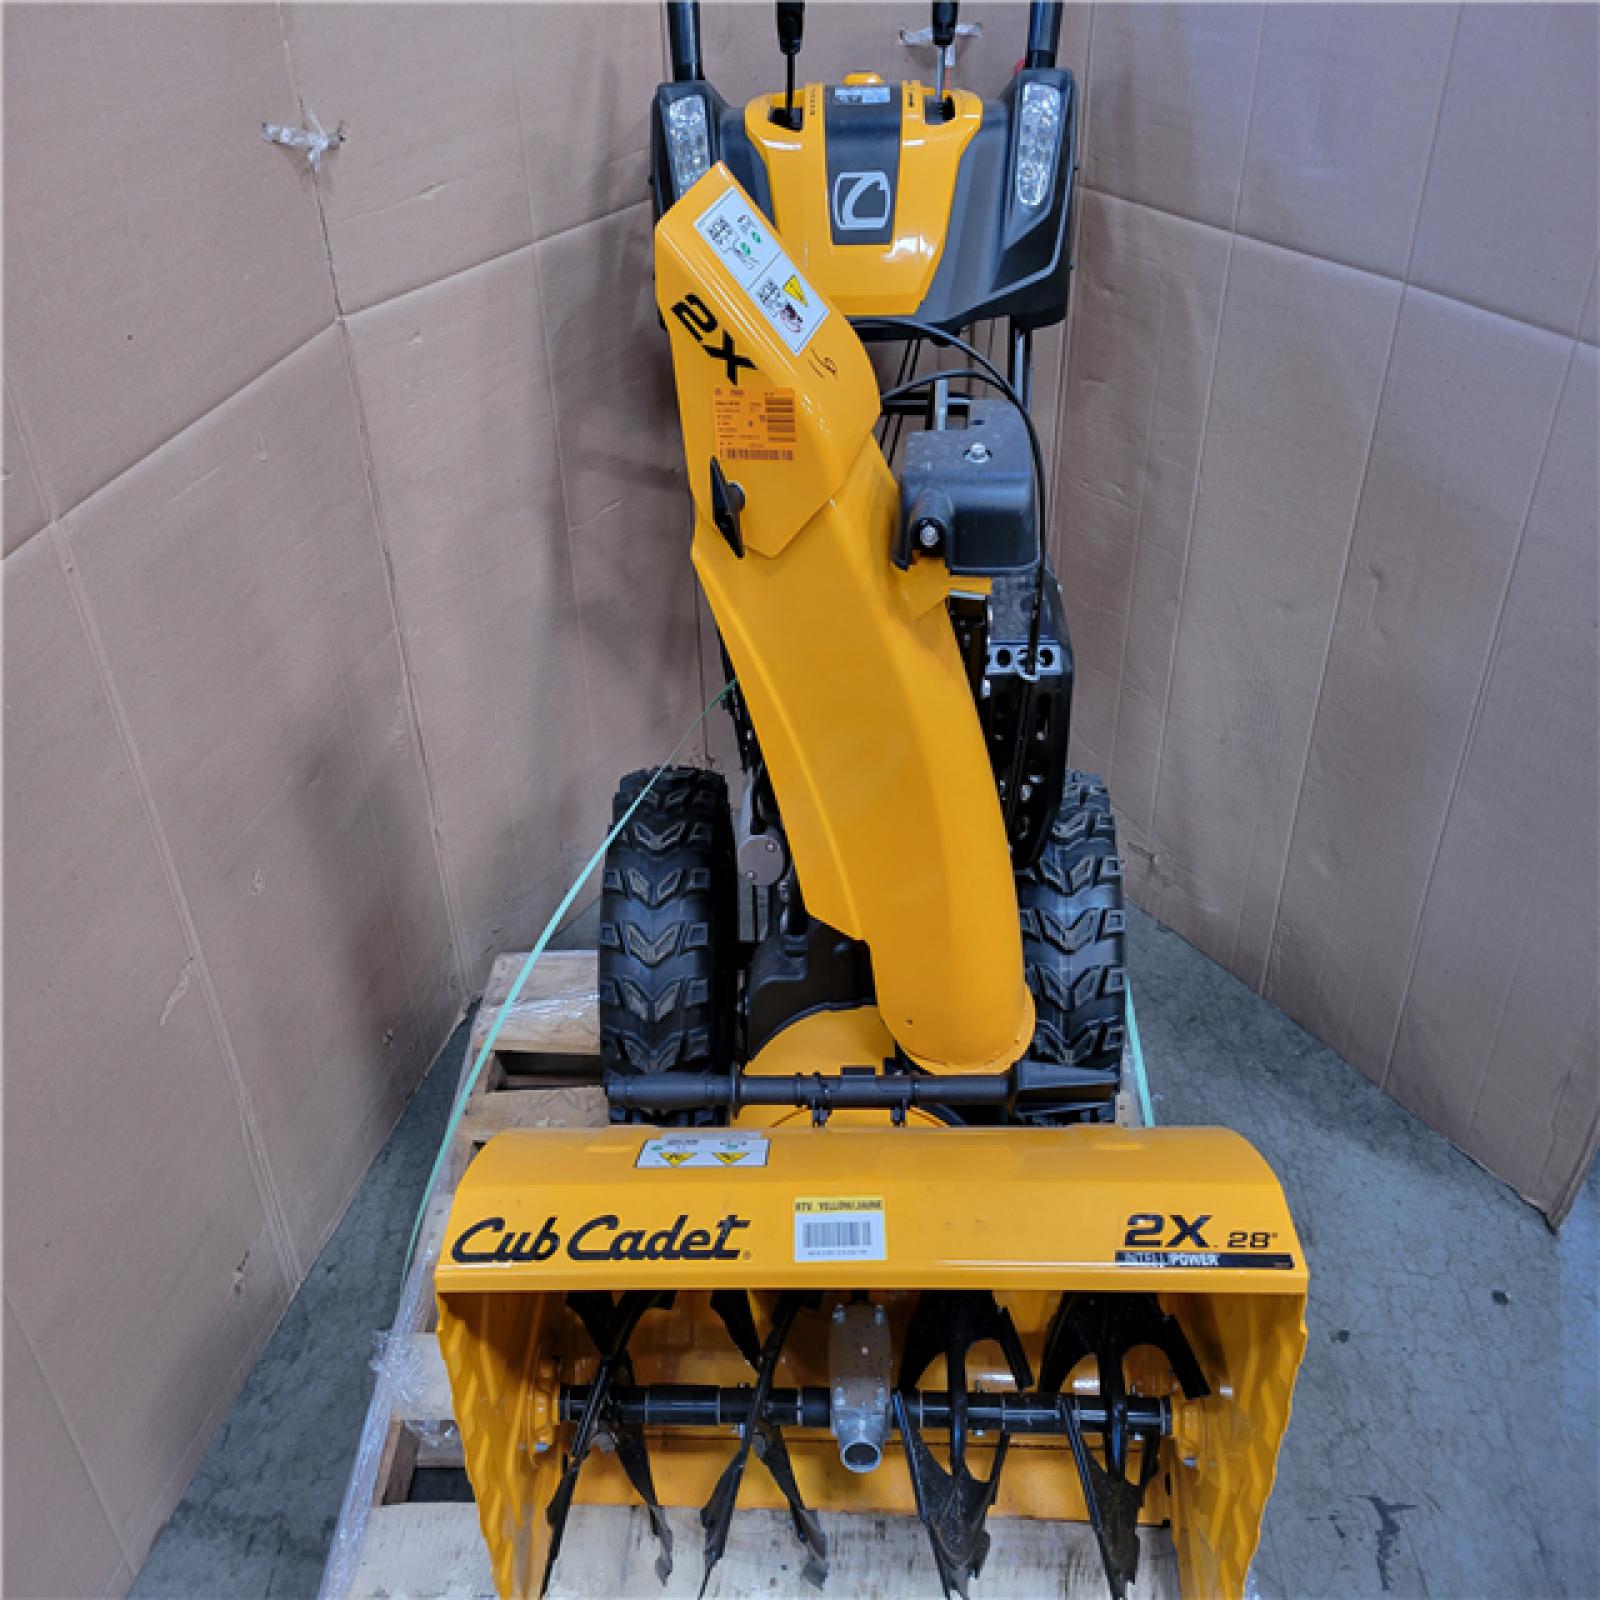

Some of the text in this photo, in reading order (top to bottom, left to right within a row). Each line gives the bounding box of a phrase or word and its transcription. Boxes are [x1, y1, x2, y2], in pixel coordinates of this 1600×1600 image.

[670, 293, 758, 386] 2X
[451, 1214, 751, 1263] Cub Cadet
[1124, 1213, 1213, 1248] 2X
